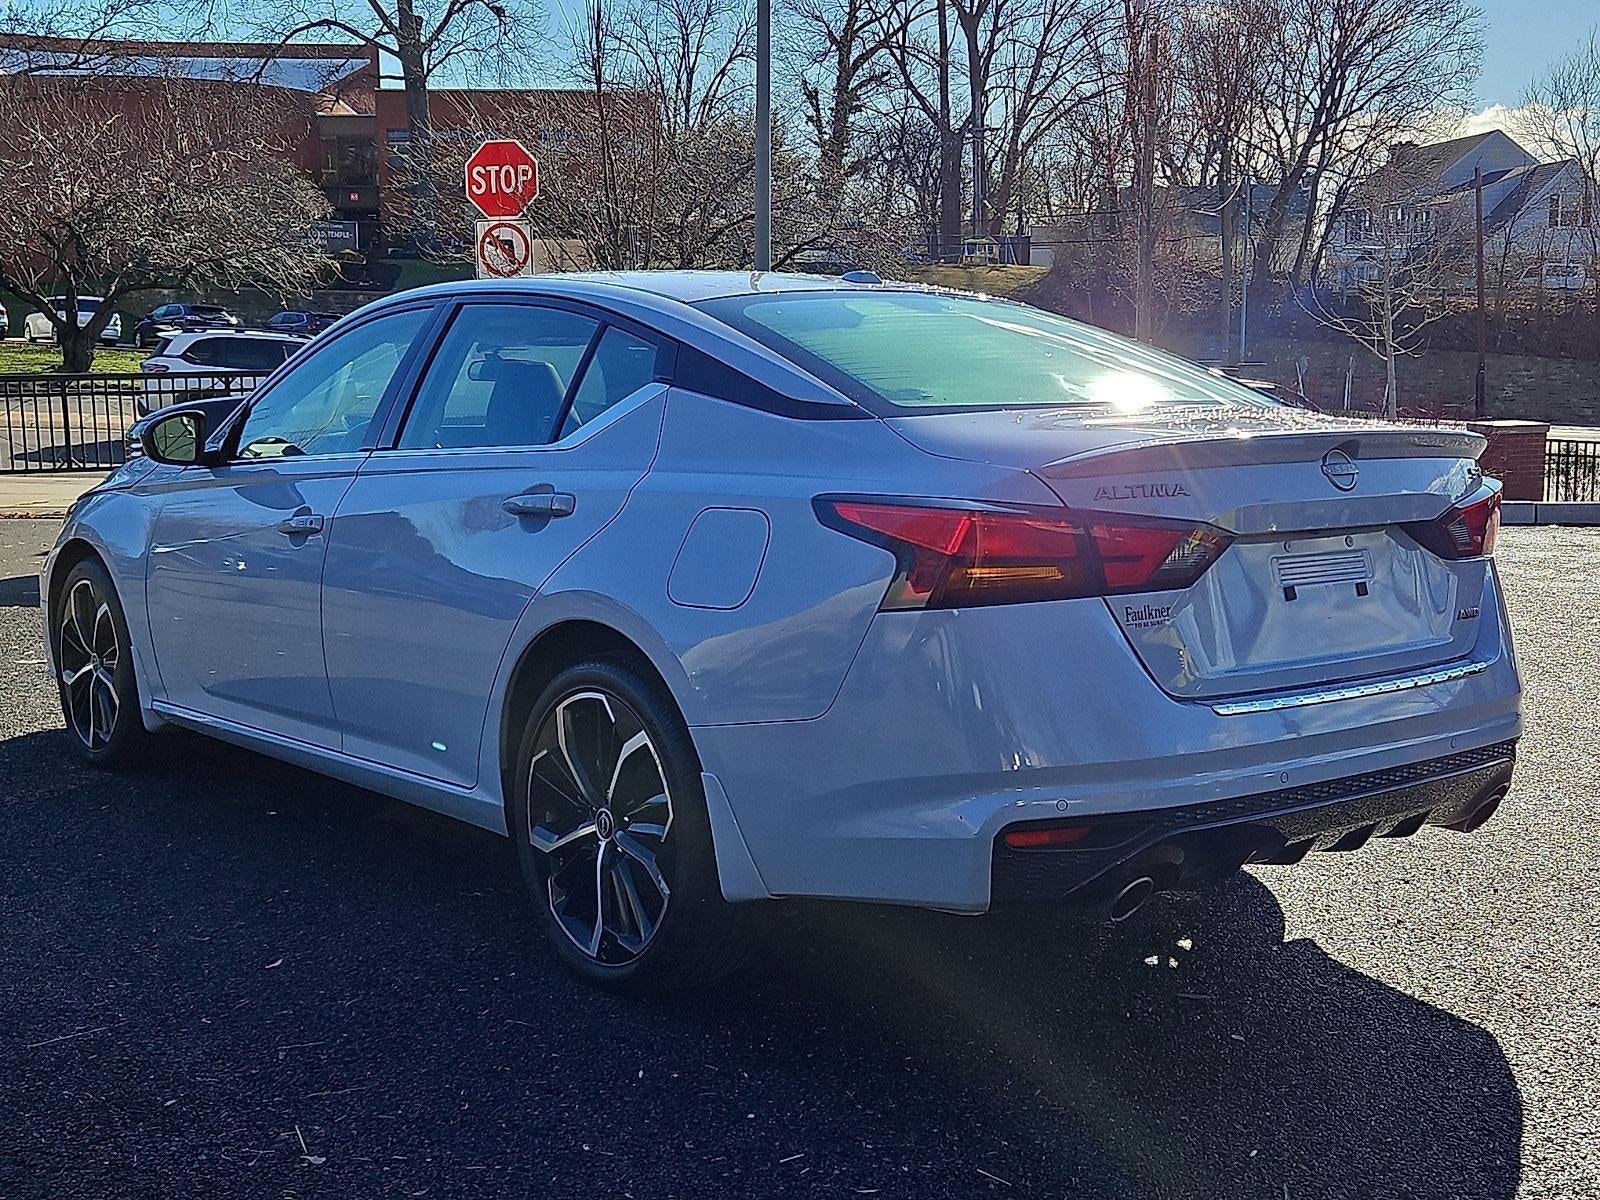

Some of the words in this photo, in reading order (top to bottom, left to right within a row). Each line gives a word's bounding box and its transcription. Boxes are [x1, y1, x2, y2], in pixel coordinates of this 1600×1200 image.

[471, 164, 533, 195] STOP
[1093, 483, 1191, 501] ALTIMA
[1124, 604, 1171, 623] Faulkner
[1456, 607, 1480, 621] AWD
